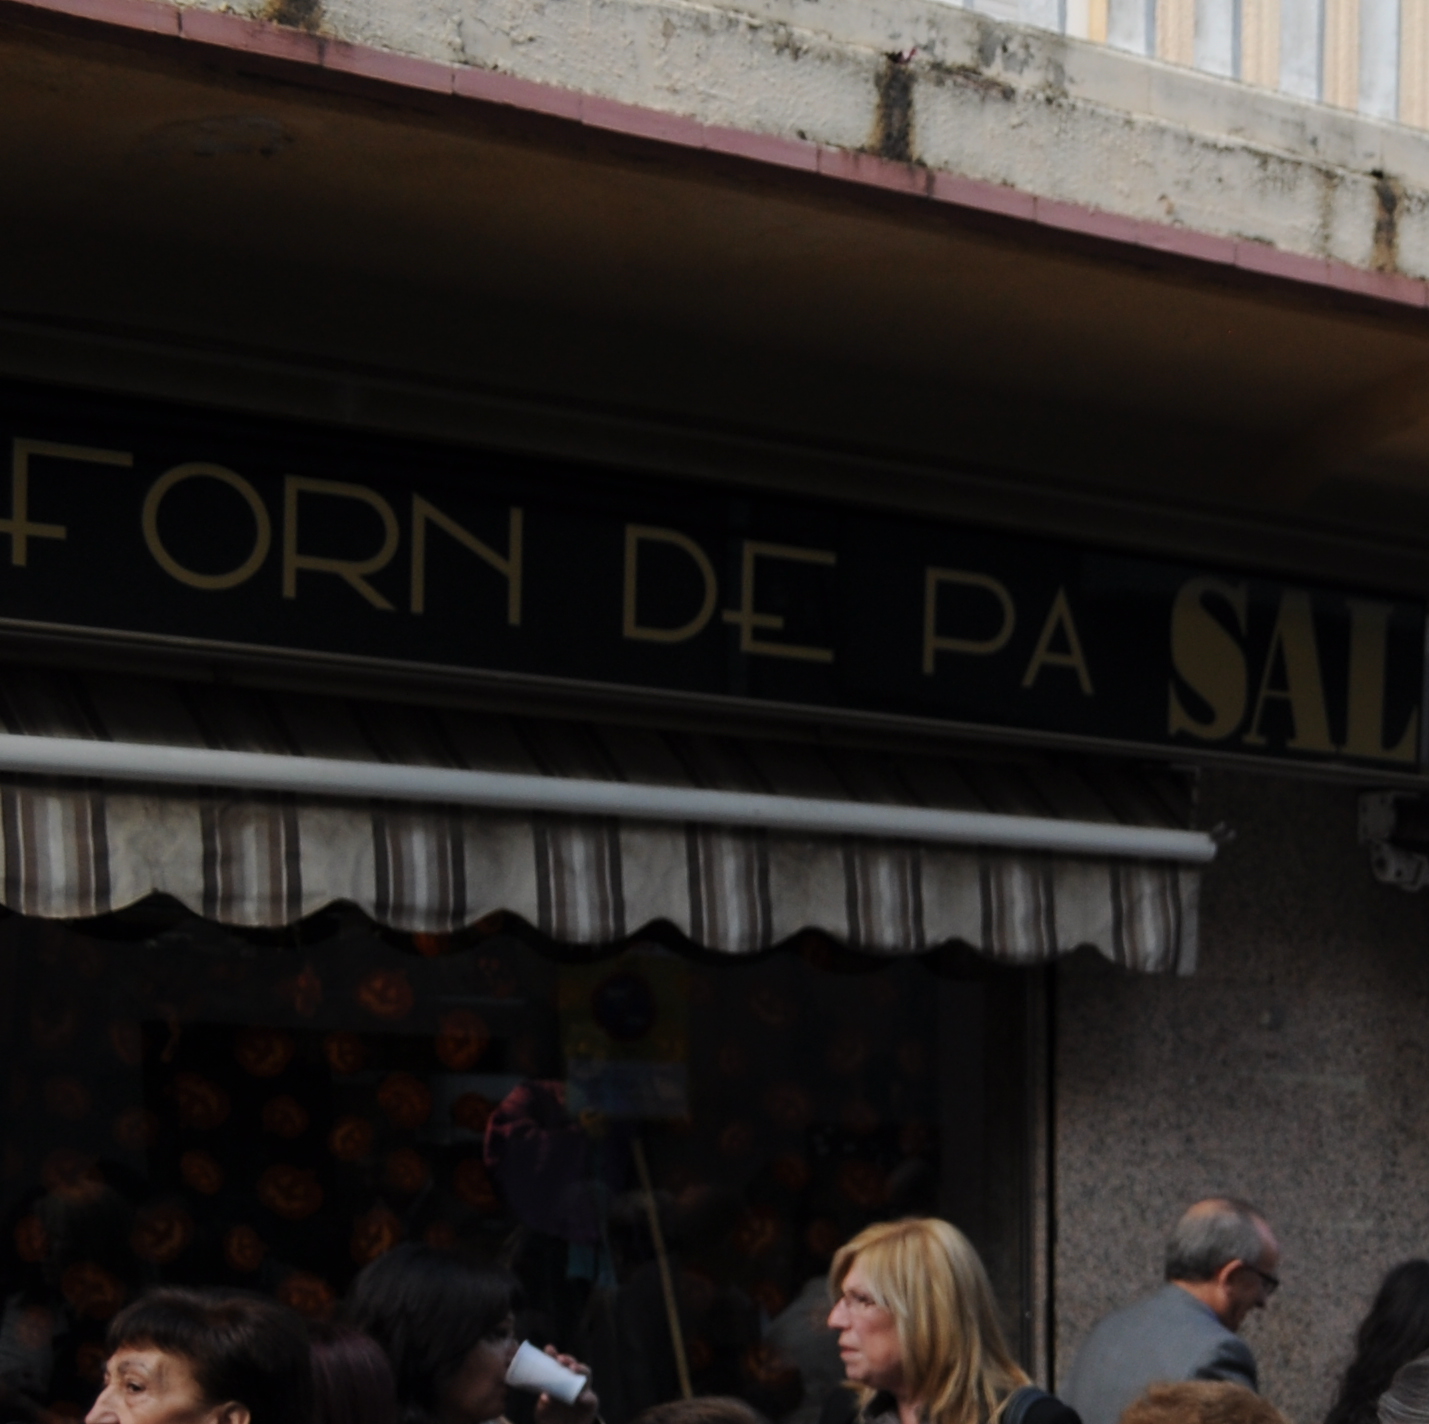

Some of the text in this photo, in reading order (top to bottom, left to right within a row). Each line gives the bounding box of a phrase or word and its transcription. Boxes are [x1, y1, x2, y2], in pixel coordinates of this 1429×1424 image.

[0, 436, 524, 628] FORN
[621, 522, 837, 664] DE
[921, 565, 1096, 697] PA
